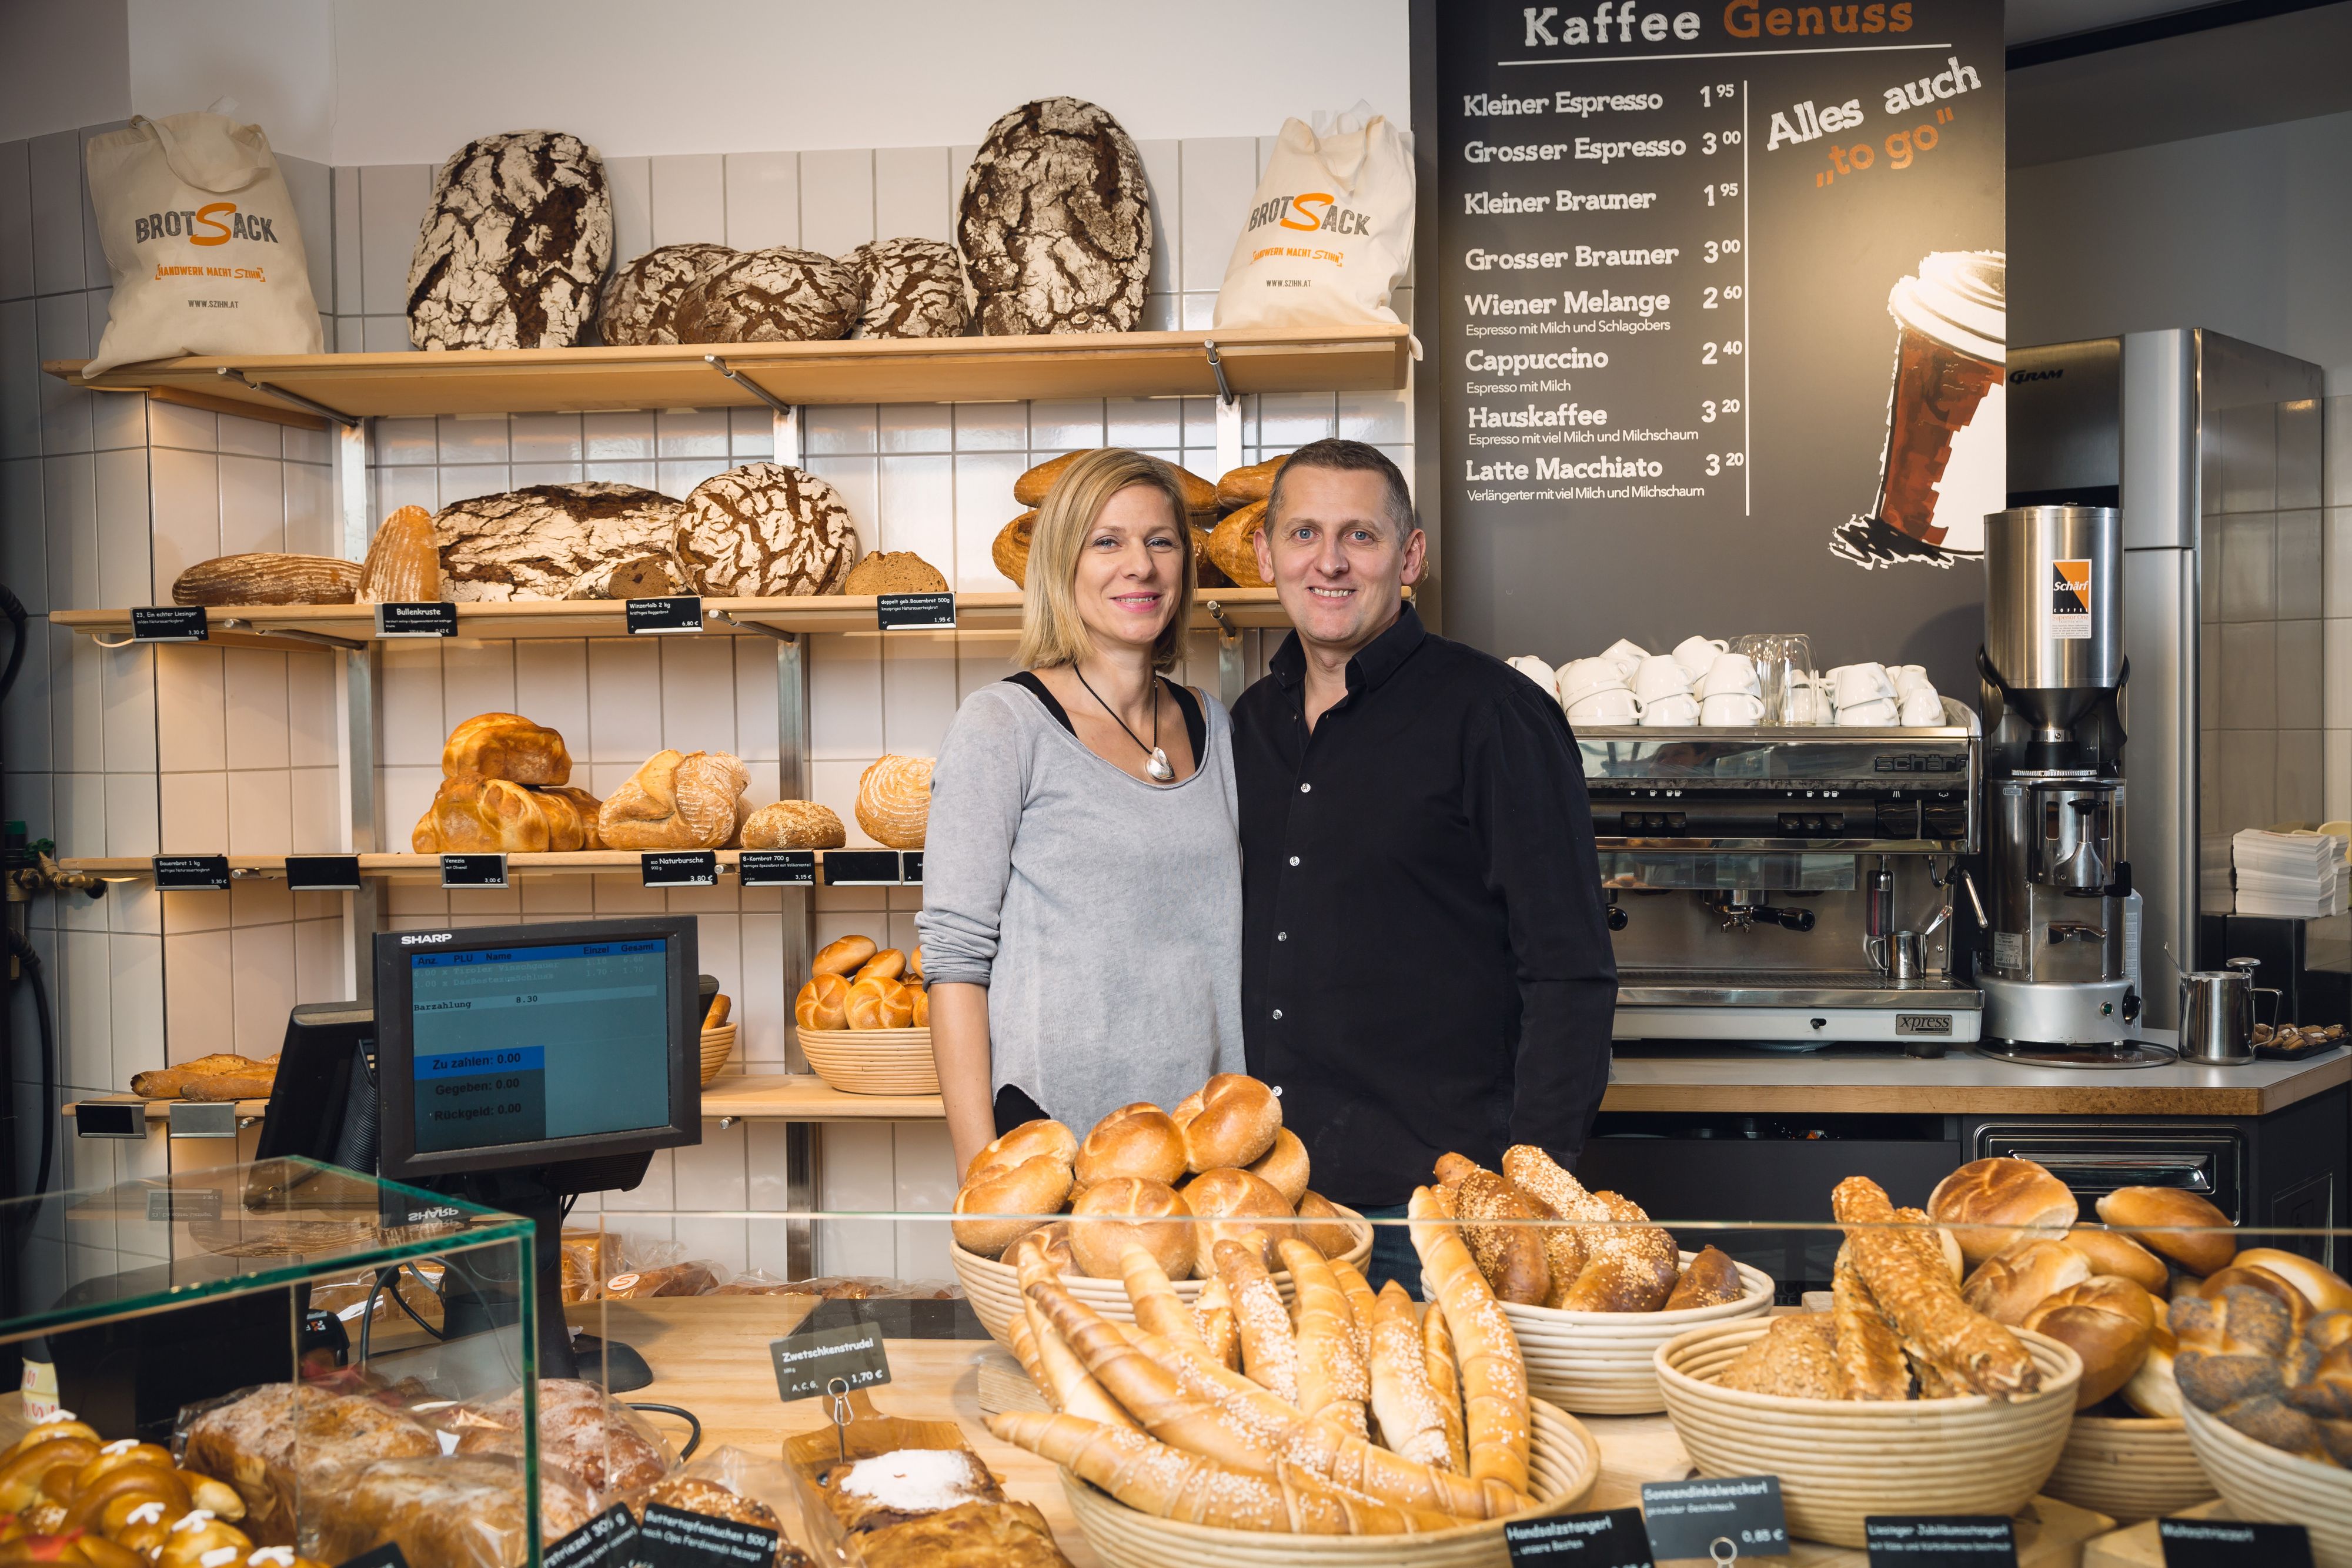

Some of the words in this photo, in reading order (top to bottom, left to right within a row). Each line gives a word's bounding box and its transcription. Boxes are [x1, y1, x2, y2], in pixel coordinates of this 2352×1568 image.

[1524, 1, 1700, 47] Kaffee
[1723, 0, 1913, 38] Genuss
[1464, 93, 1549, 116] Kleiner
[1555, 91, 1663, 118] Espresso
[1766, 99, 1864, 151] Alles
[1883, 56, 1982, 116] auch
[1464, 141, 1567, 163] Grosser
[1575, 138, 1686, 164] Espresso
[1464, 192, 1549, 215] Kleiner
[1556, 190, 1656, 212] Brauner
[1248, 192, 1371, 236] BROTSACK
[135, 202, 278, 246] BROTSACK
[1287, 248, 1311, 258] MACHT
[1465, 248, 1568, 270] Grosser
[1575, 245, 1679, 266] Brauner
[206, 268, 232, 278] MACHT
[1266, 279, 1311, 287] WWW.SZIHN.AT
[188, 299, 239, 309] WWW.SZIHN.AT
[1464, 293, 1556, 316] Wiener
[1564, 290, 1670, 316] Melange
[1466, 324, 1516, 337] Espresso
[1519, 323, 1538, 334] mit
[1541, 322, 1571, 334] Milch
[1573, 320, 1596, 333] und
[1598, 319, 1671, 335] Schlagobers
[1465, 347, 1609, 376] Cappuccino
[1467, 382, 1517, 394] Espresso
[1520, 380, 1538, 392] mit
[1541, 380, 1571, 392] Milch
[1468, 403, 1608, 428] Hauskaffee
[1469, 433, 1519, 447] Espresso
[1522, 432, 1540, 444] mit
[1542, 432, 1561, 443] viel
[1564, 430, 1594, 443] Milch
[1597, 430, 1620, 442] und
[1623, 429, 1699, 442] Milchschaum
[1466, 459, 1529, 481] Latte
[1536, 456, 1663, 480] Macchiato
[1468, 489, 1534, 503] Verlängerter
[1536, 489, 1555, 500] mit
[1555, 488, 1573, 500] viel
[1575, 487, 1605, 499] Milch
[1607, 486, 1629, 499] und
[1632, 485, 1705, 498] Milchschaum
[2053, 580, 2089, 591] Schärf
[659, 857, 704, 865] Naturbursche
[402, 933, 452, 945] SHARP
[453, 954, 473, 962] PLU
[486, 952, 512, 961] Name
[583, 945, 609, 955] Einzel
[621, 943, 654, 952] Gesamt
[454, 966, 493, 974] Tiroler
[414, 1001, 472, 1011] Barzahlung
[516, 995, 538, 1004] 8.30
[432, 1059, 449, 1070] Zu
[451, 1054, 494, 1069] zahlen:
[497, 1053, 521, 1064] 0.00
[435, 1080, 492, 1096] Gegeben:
[496, 1078, 520, 1089] 0.00
[435, 1105, 495, 1121] Rückgeld:
[497, 1103, 522, 1115] 0.00
[782, 1338, 874, 1363] Zwetschkenstrudel
[851, 1370, 874, 1383] 1,70
[875, 1369, 883, 1379] €
[641, 1527, 663, 1540] nach
[663, 1530, 682, 1544] Opa
[645, 1509, 744, 1543] Buttertopfenkuchen
[746, 1532, 767, 1547] 500
[768, 1539, 777, 1552] g
[1506, 1515, 1612, 1540] Handsalzstangerl
